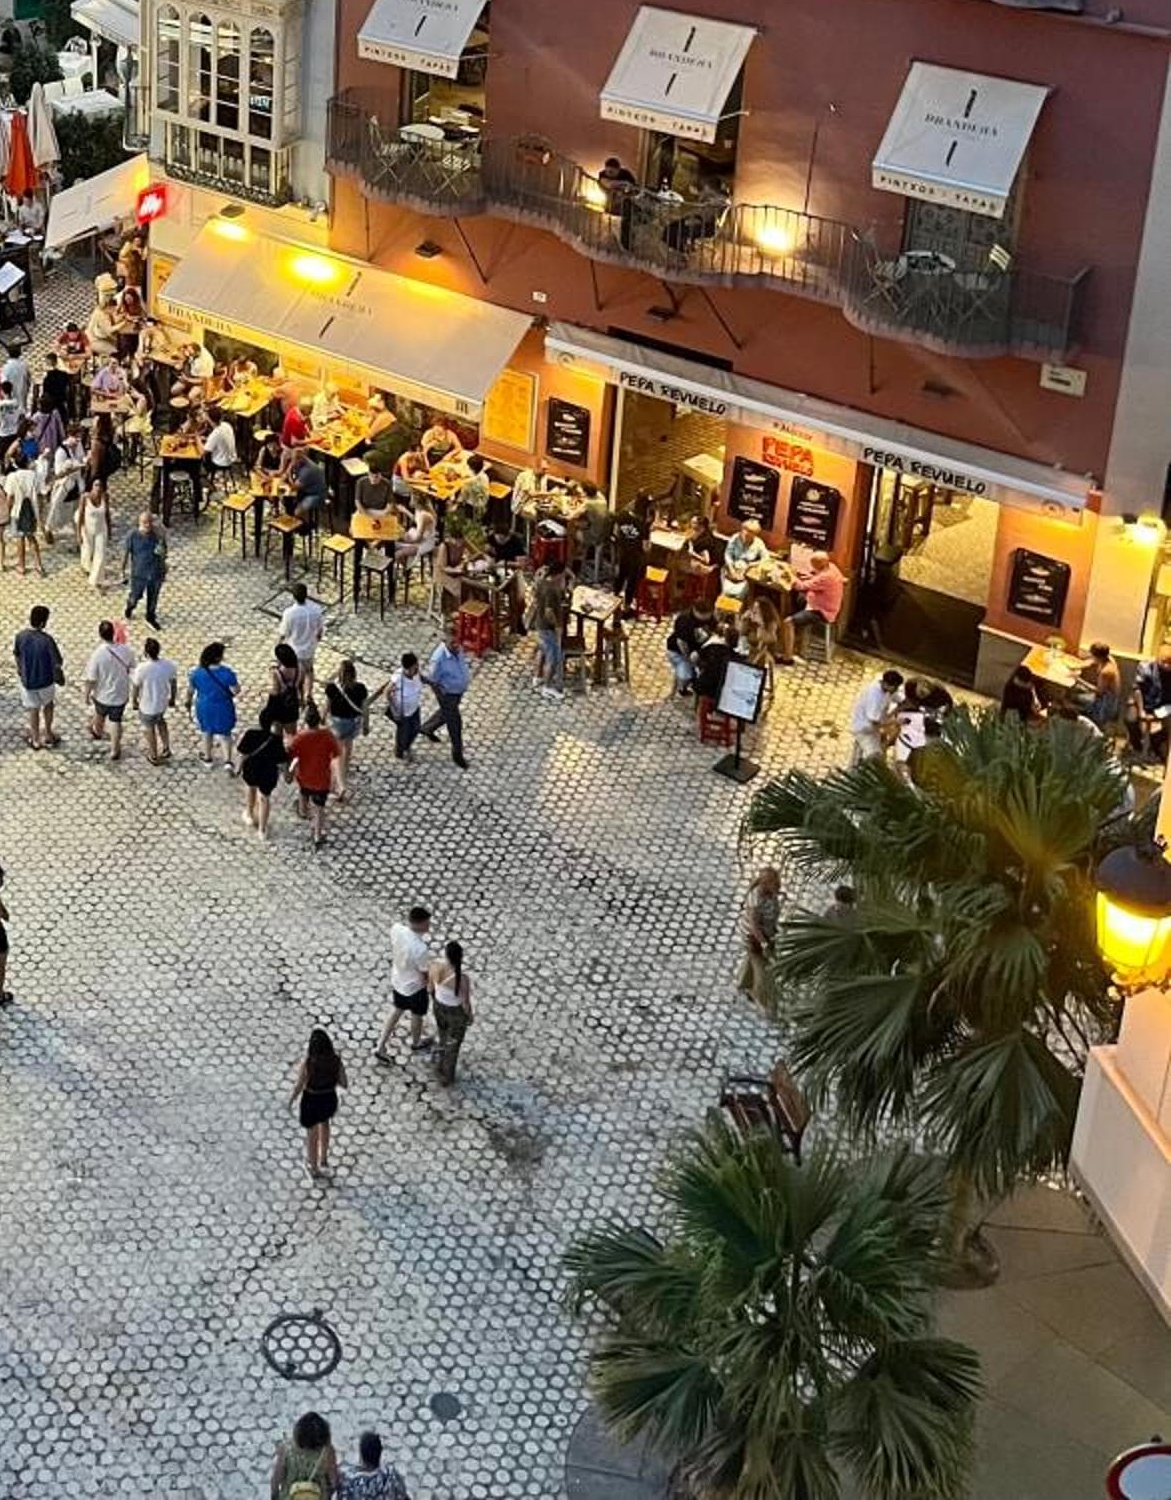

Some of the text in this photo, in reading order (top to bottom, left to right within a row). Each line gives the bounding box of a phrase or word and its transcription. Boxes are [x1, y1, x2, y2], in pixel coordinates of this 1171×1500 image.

[880, 175, 998, 212] PINTXOS TAPAS
[620, 371, 727, 416] PEPA REVUELO
[762, 436, 814, 463] PEPA
[863, 447, 987, 495] PEPA REVUELO
